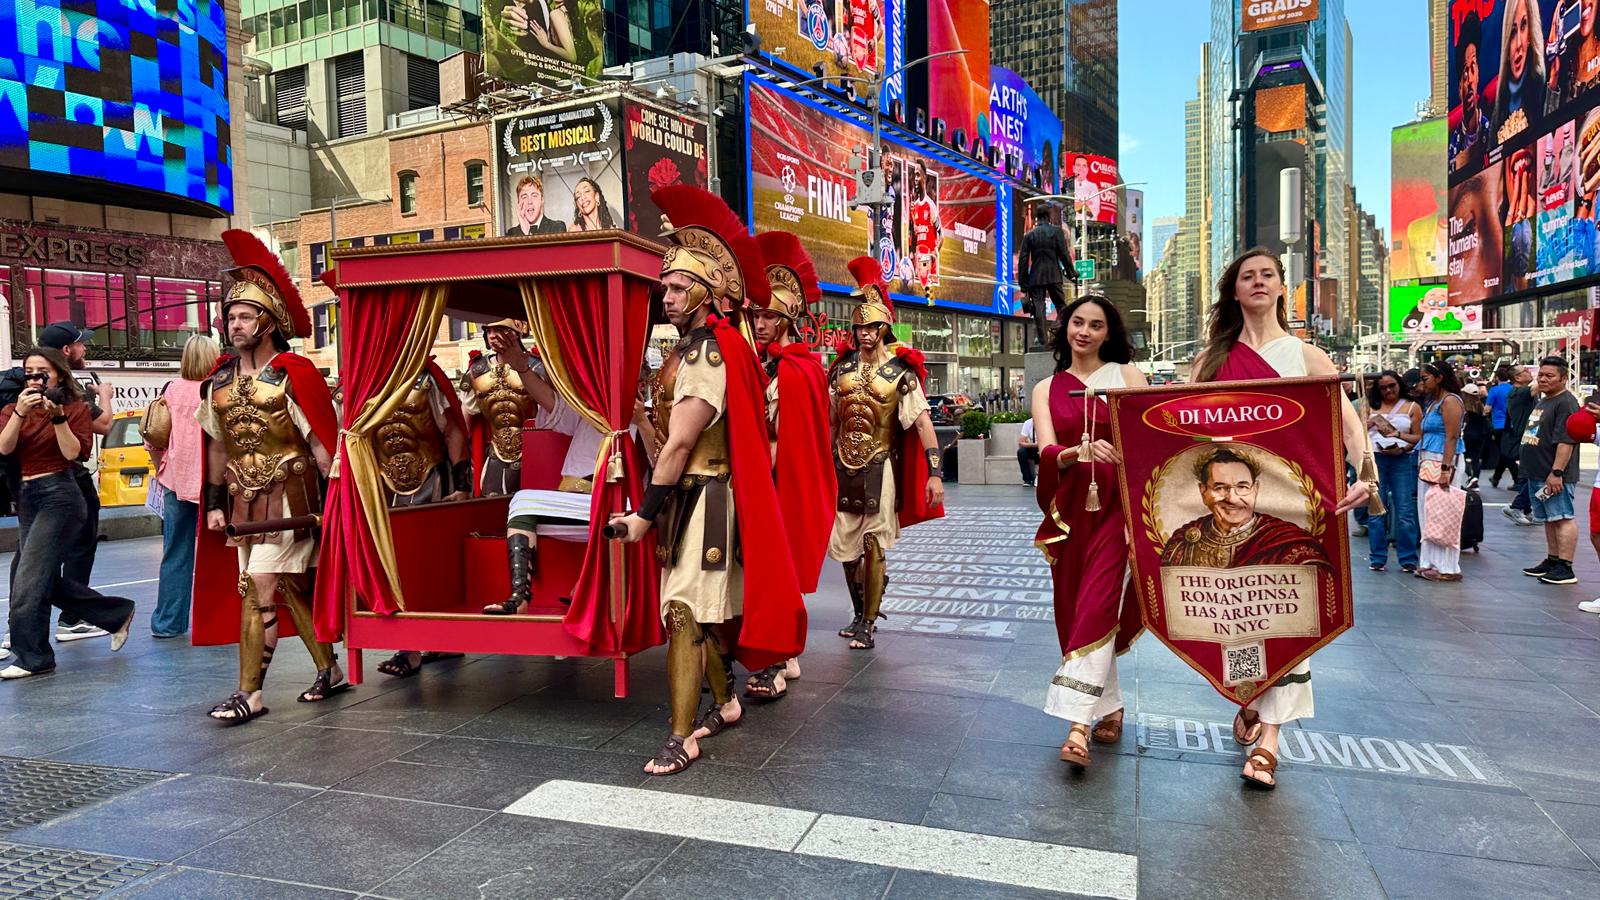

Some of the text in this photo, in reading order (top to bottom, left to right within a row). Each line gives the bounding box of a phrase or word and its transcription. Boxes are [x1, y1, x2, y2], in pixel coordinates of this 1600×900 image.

[1248, 0, 1312, 16] GRADS
[528, 52, 560, 64] BROADWAY
[561, 61, 585, 72] THEATRE
[544, 64, 574, 76] BROADWAY
[990, 82, 1028, 120] ARTH'S
[519, 120, 524, 130] 8
[524, 118, 538, 128] TONY
[558, 108, 595, 122] NOMINATIONS
[641, 108, 694, 138] COME SEE HOW THE
[990, 111, 1024, 144] INEST
[520, 124, 596, 153] BEST MUSICAL
[630, 120, 705, 160] WORLD COULD BE
[808, 174, 852, 223] FINAL
[774, 202, 804, 216] CHAMPIONS
[780, 211, 801, 222] LEAGUE
[1449, 216, 1463, 237] The
[1542, 215, 1568, 233] summer
[1, 232, 146, 268] EXPRESS
[1449, 232, 1478, 256] humans
[1449, 257, 1464, 279] stay
[1179, 404, 1283, 426] DI MARCO
[888, 552, 978, 562] KERR
[887, 562, 1052, 576] MBASSAD
[1176, 573, 1301, 590] THE ORIGINAL
[892, 585, 1053, 602] SIMO
[1180, 588, 1299, 606] ROMAN PINSA
[881, 598, 1010, 617] ROADWAY
[1184, 602, 1298, 621] HAS ARRIVED
[912, 617, 1013, 638] 54
[1213, 618, 1270, 635] IN NYC
[1174, 718, 1488, 780] BEUMONT
